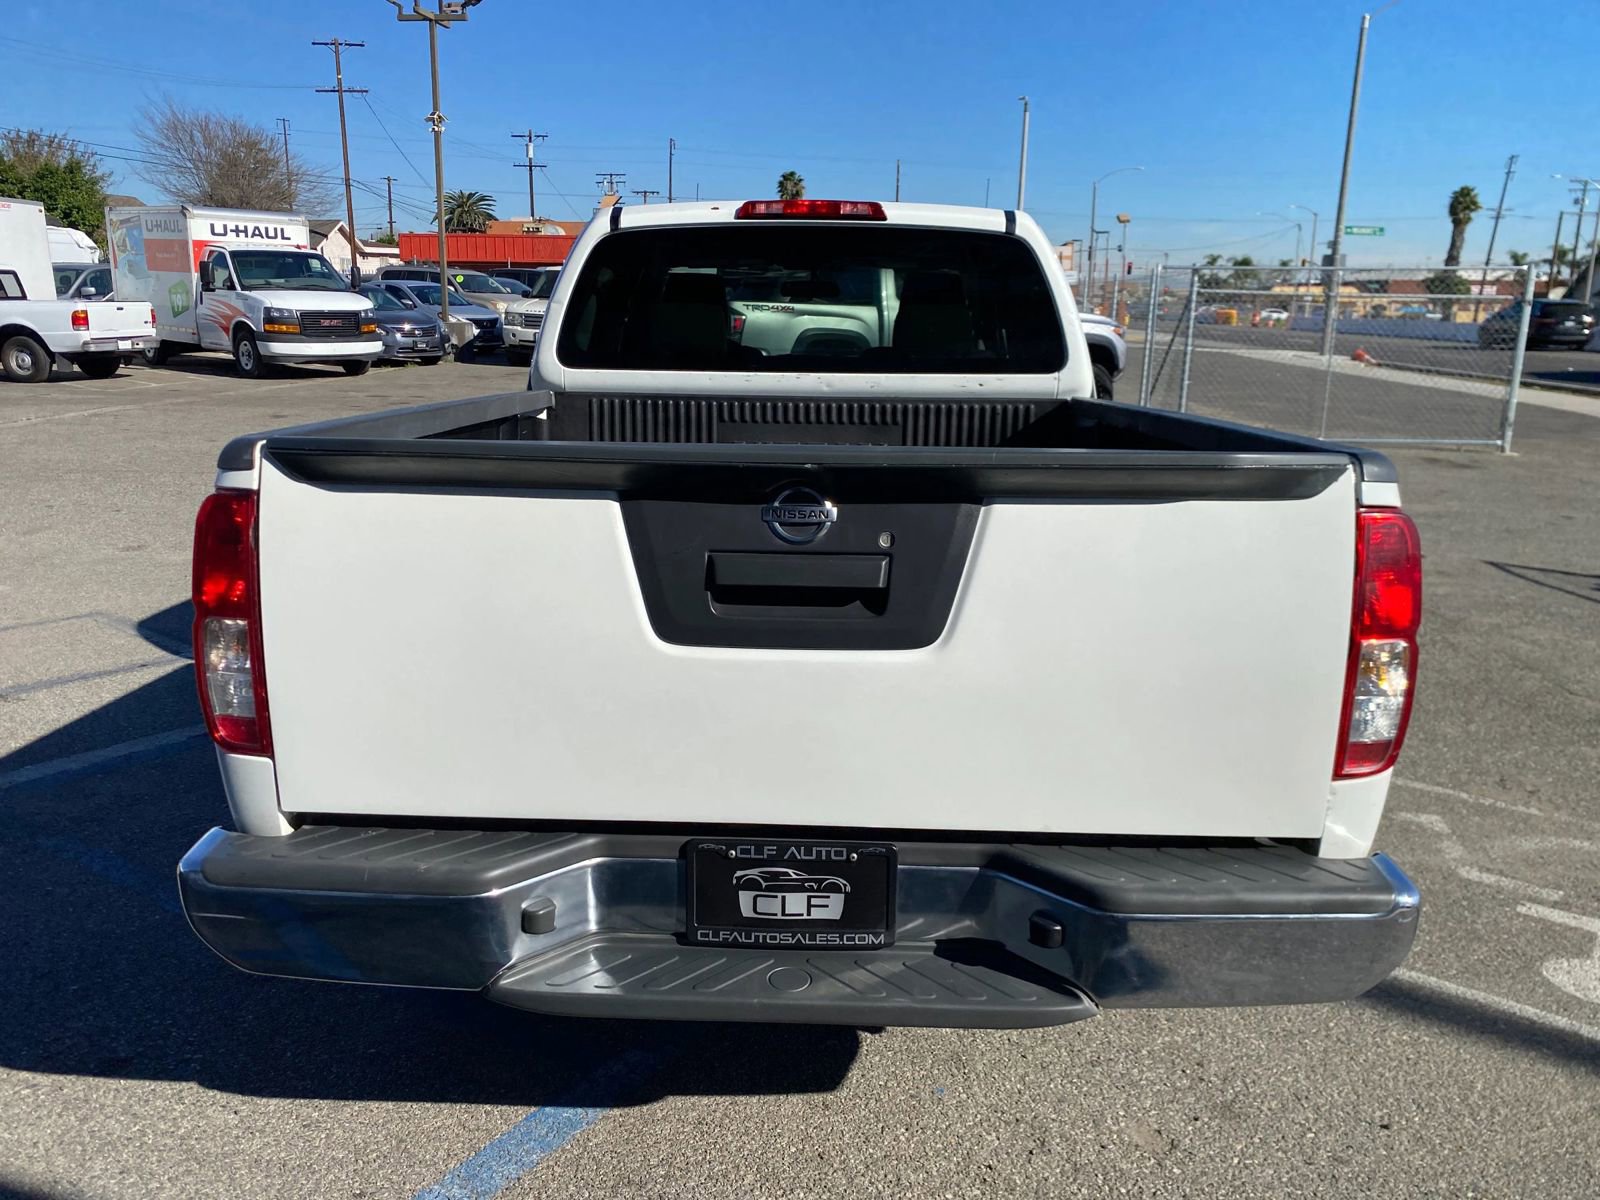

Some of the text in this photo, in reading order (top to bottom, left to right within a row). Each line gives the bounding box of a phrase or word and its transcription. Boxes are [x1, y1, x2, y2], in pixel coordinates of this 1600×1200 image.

[145, 219, 183, 233] U-HAUL
[209, 222, 292, 241] U-HAUL
[771, 509, 829, 520] NISSAN
[736, 845, 847, 861] CLF AUTO
[752, 893, 831, 918] CLF
[697, 930, 885, 945] CLFAUTOSALES.COM
